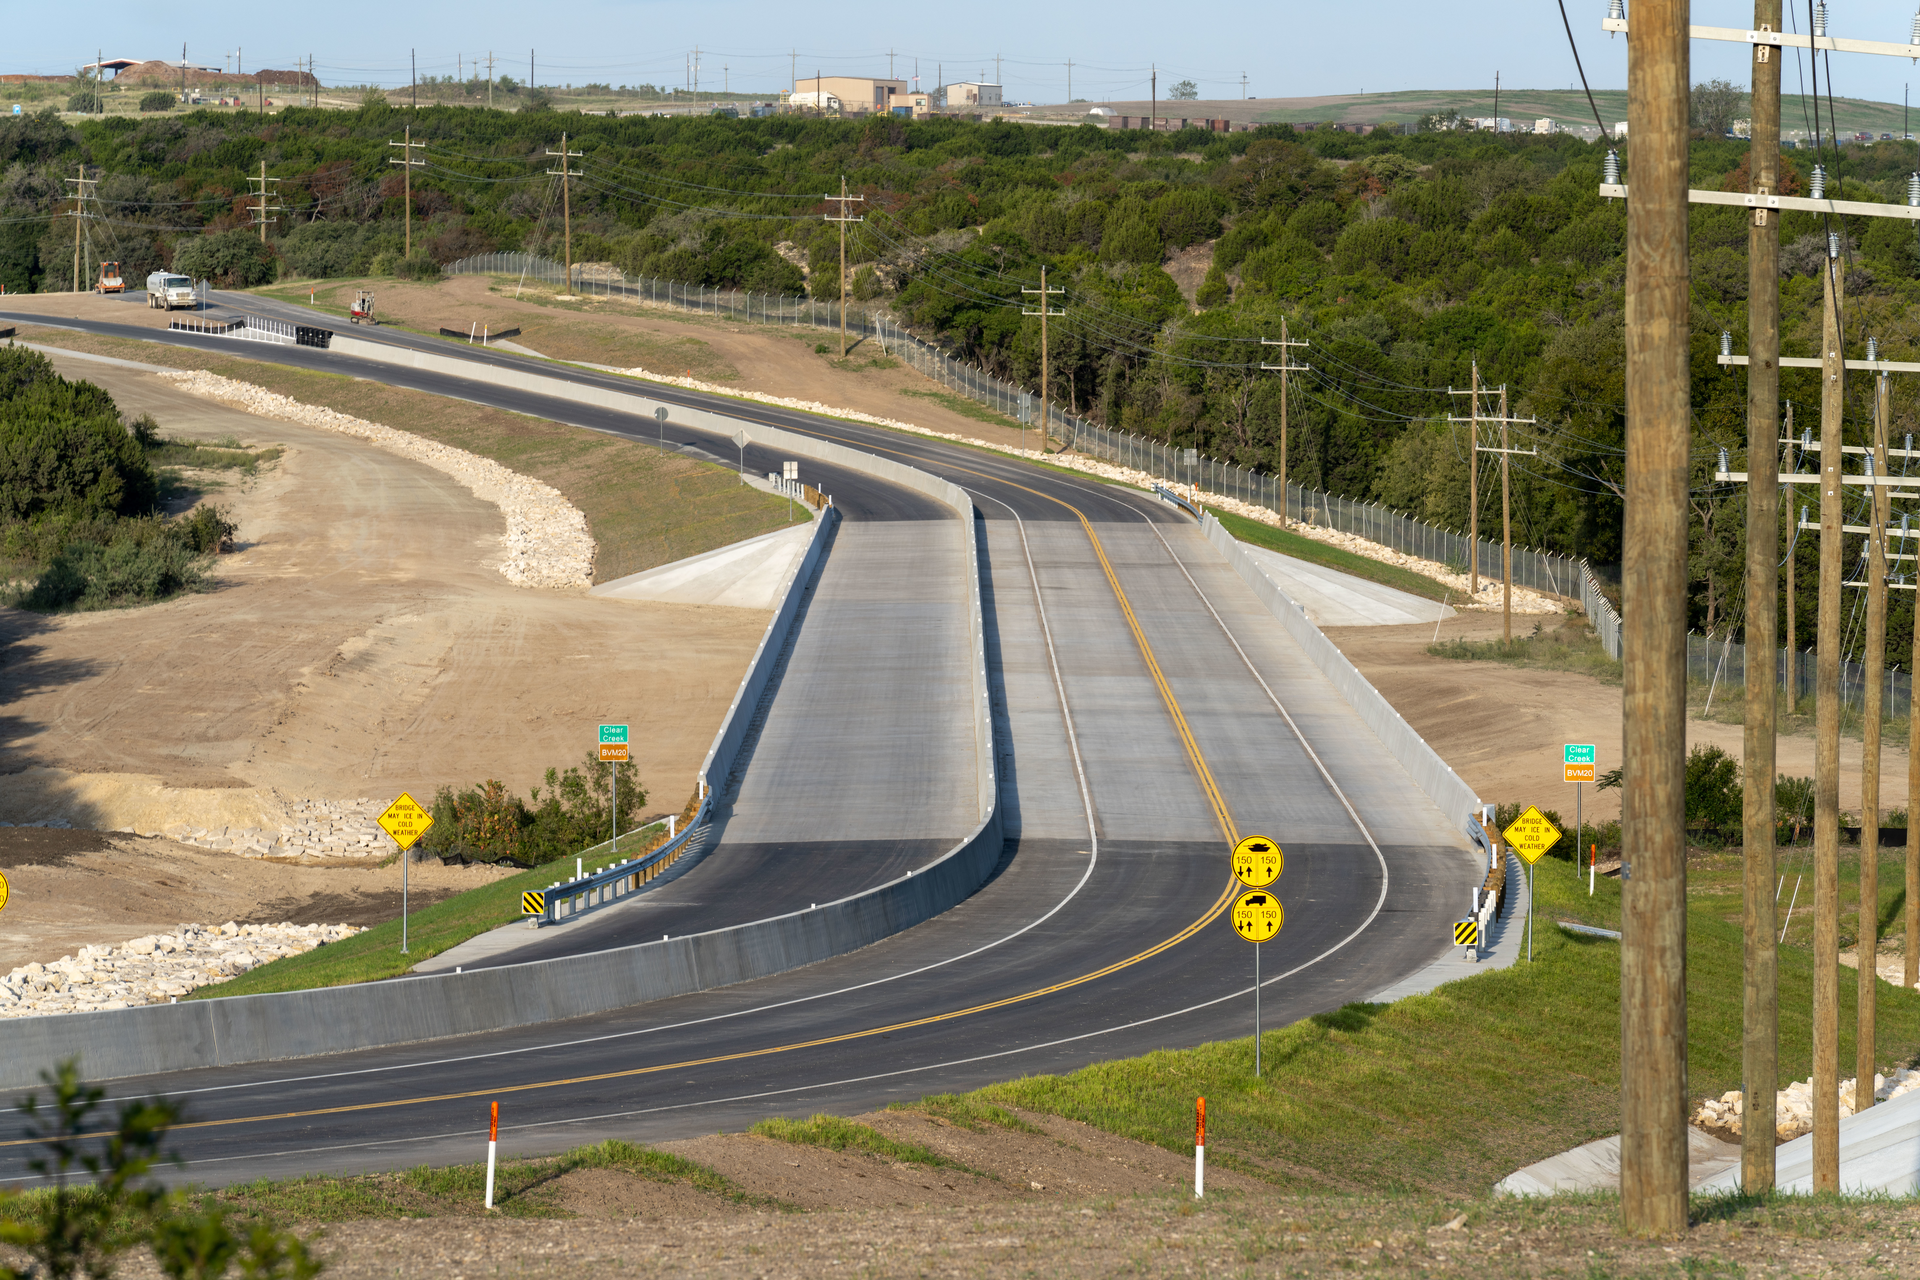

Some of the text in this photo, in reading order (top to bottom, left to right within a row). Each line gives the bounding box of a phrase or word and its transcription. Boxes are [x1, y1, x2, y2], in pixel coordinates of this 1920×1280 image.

[601, 749, 627, 757] BVM20
[1569, 745, 1590, 753] Clear
[1568, 754, 1591, 762] Creek
[1566, 769, 1593, 777] BVM20
[1521, 817, 1542, 825] BRIDGE
[1524, 834, 1540, 842] COLD
[1236, 855, 1277, 865] 150 150
[1236, 910, 1277, 919] 150 150
